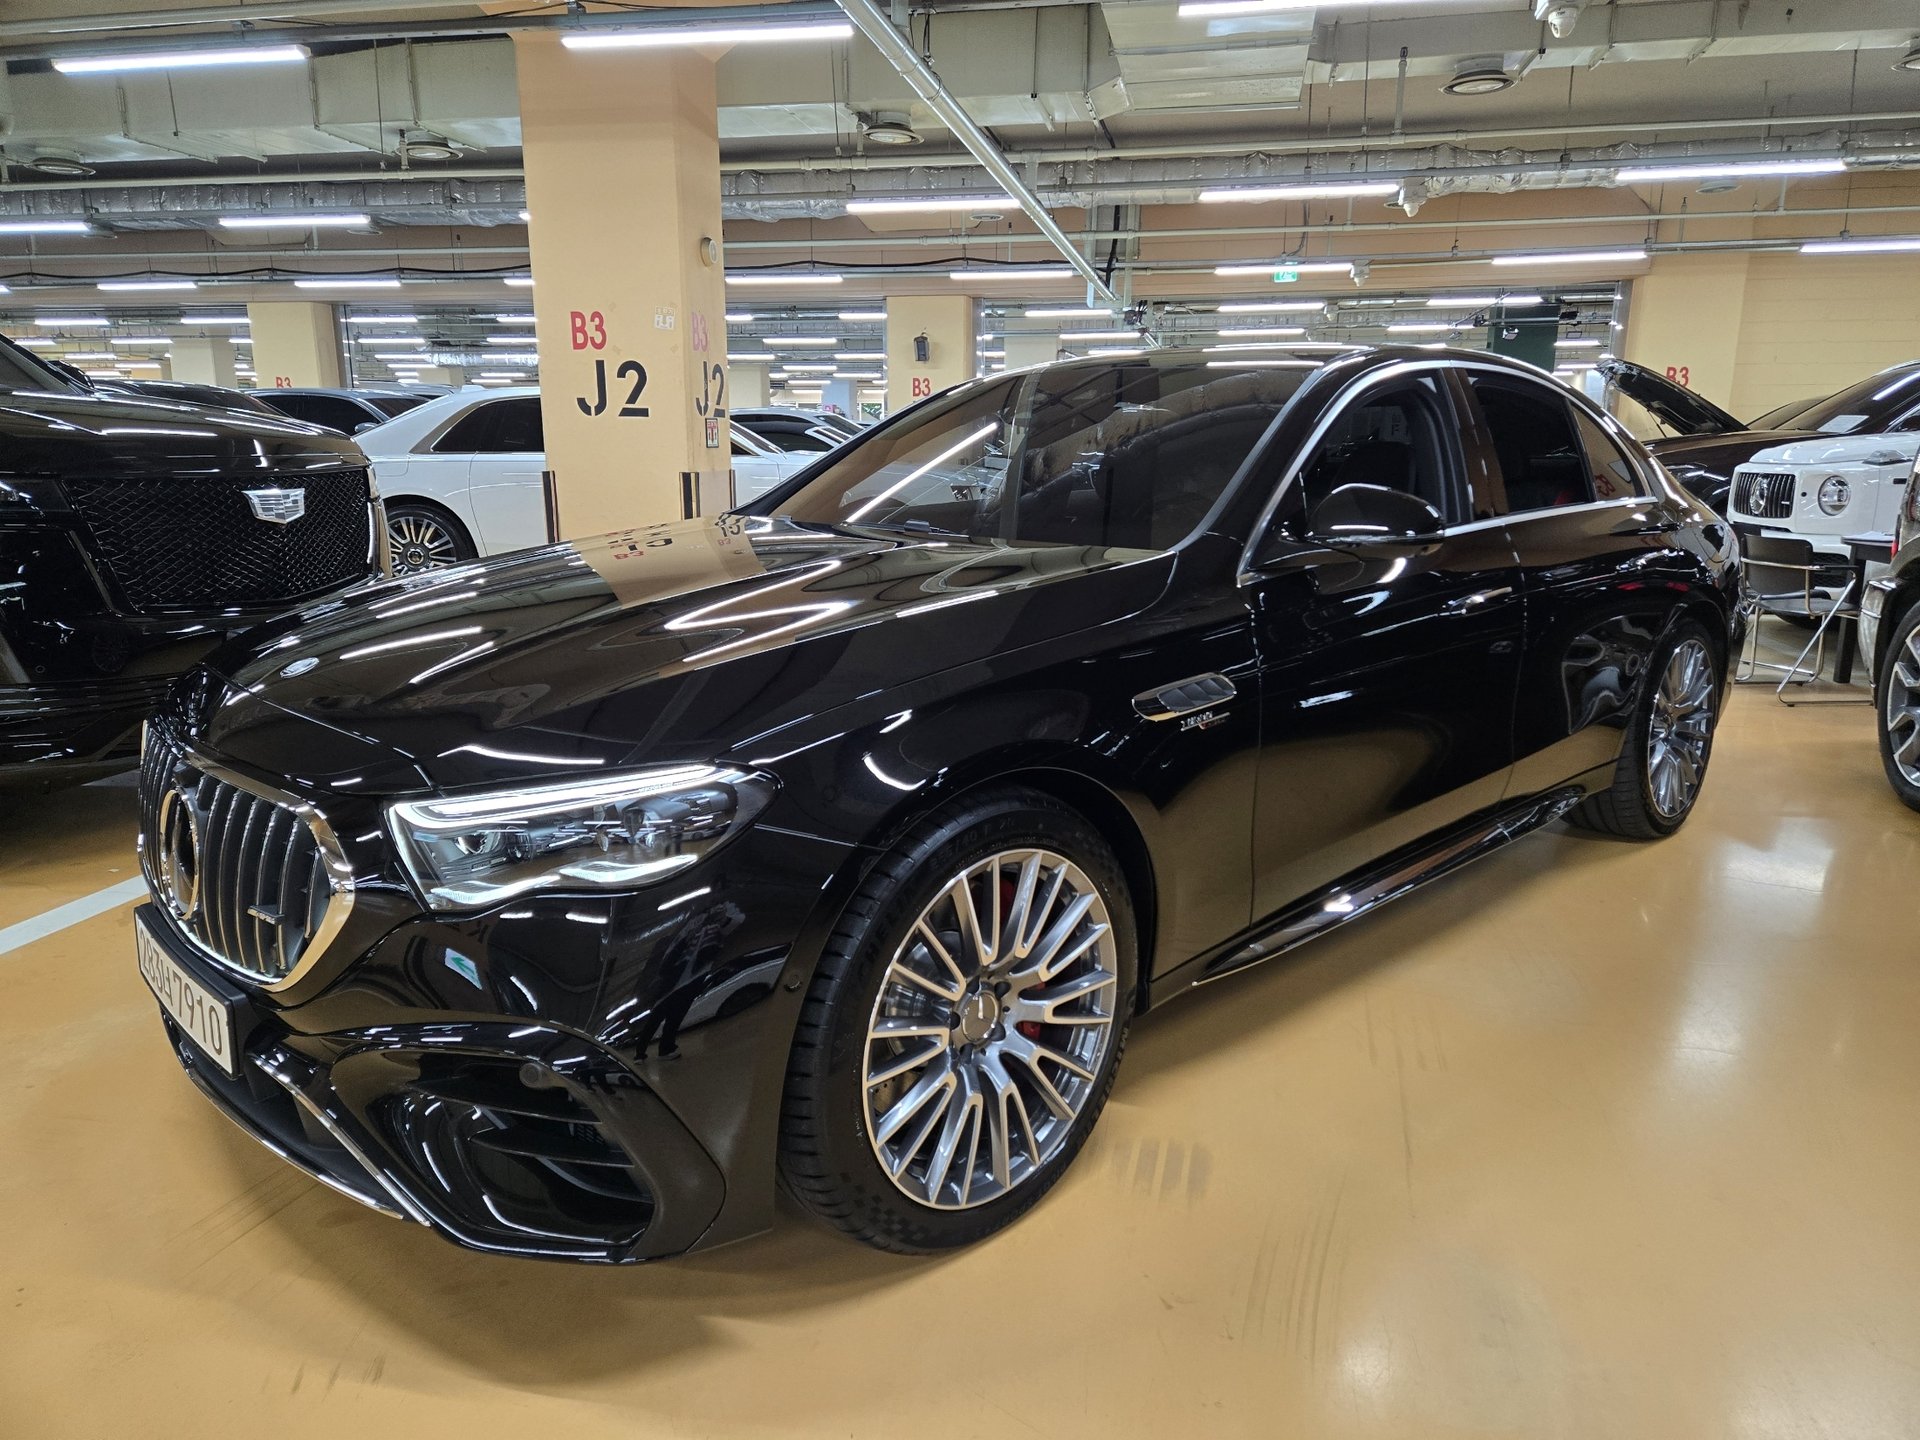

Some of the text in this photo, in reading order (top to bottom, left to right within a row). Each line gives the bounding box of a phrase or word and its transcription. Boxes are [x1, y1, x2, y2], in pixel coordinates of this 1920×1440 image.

[570, 311, 607, 351] B3
[692, 312, 708, 352] B3
[576, 359, 649, 417] J2
[695, 360, 726, 418] J2
[912, 377, 931, 397] B3
